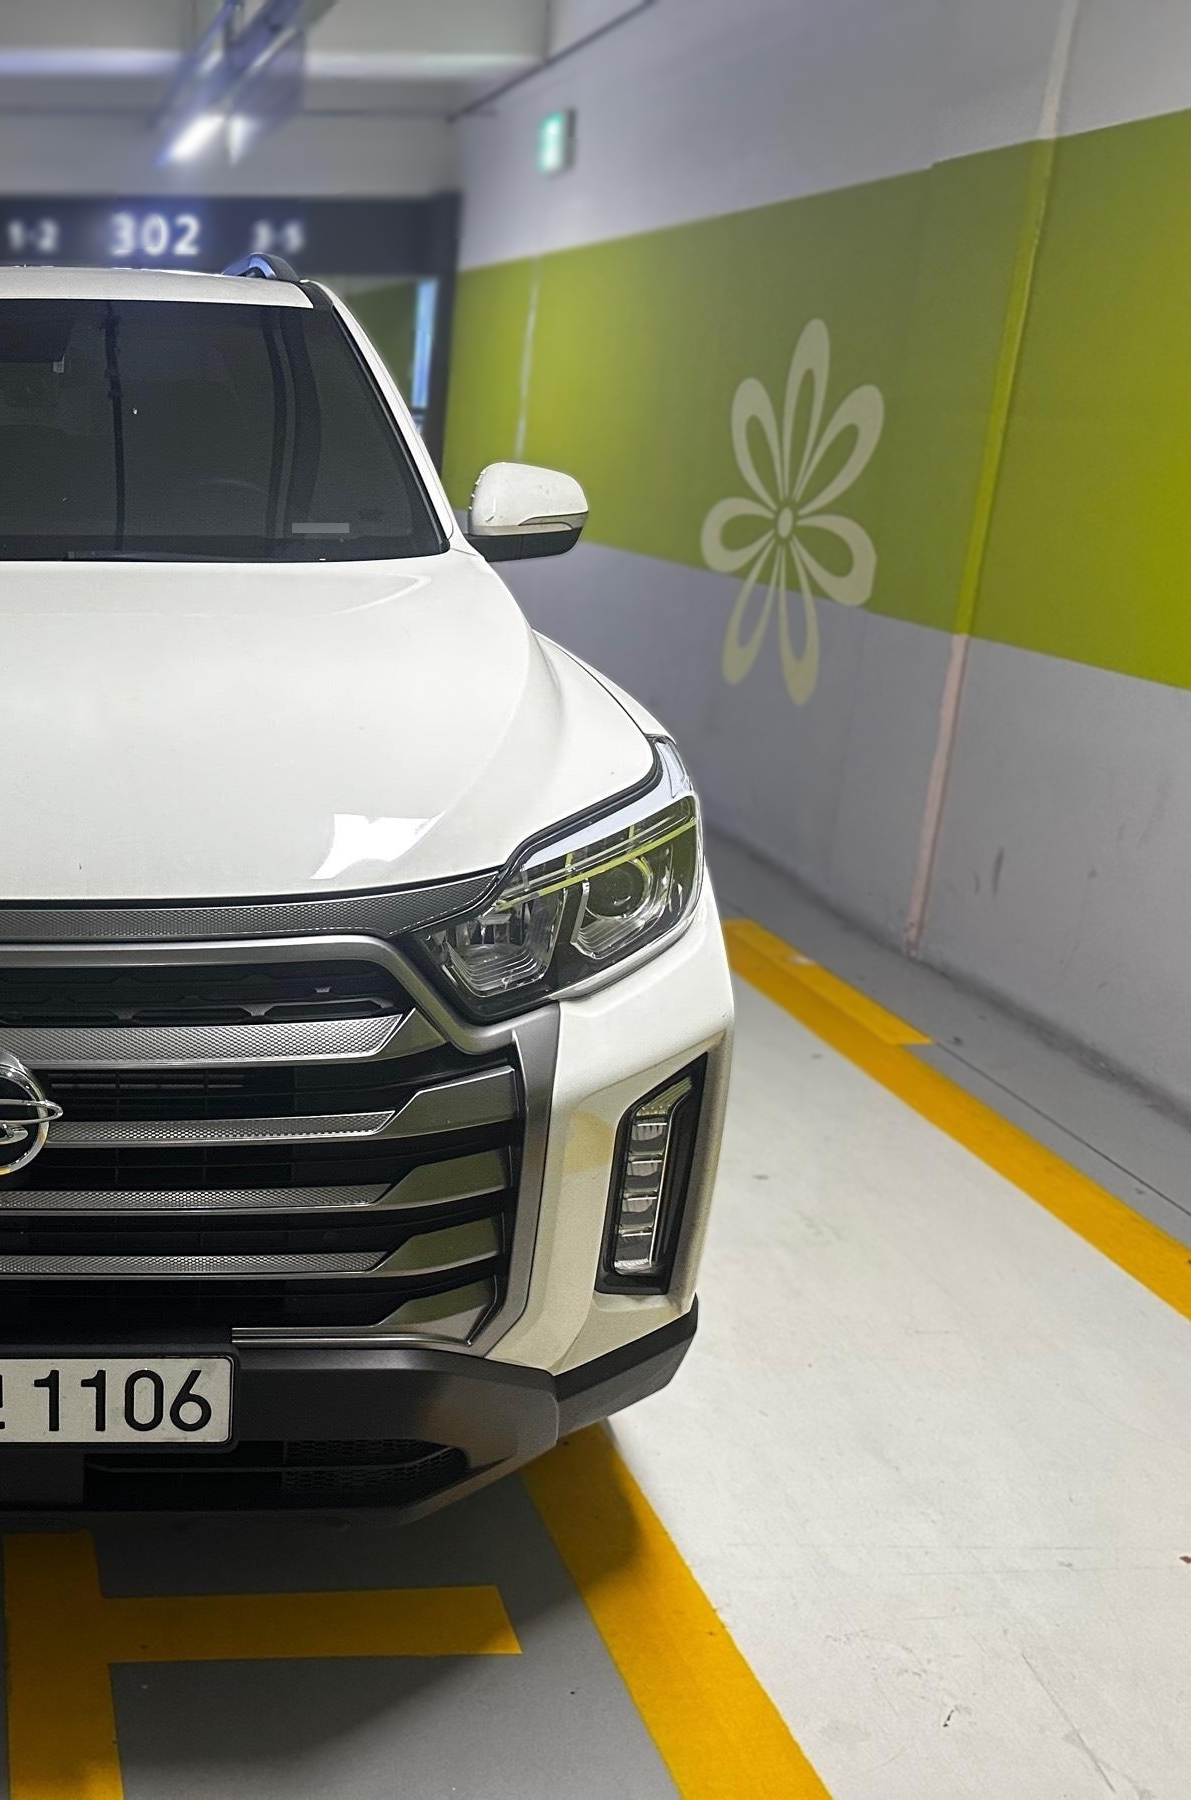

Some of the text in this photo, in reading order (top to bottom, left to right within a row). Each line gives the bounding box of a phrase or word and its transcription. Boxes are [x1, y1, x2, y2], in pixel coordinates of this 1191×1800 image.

[7, 218, 59, 253] 1-2
[110, 212, 201, 255] 302
[33, 1369, 212, 1432] 1106
